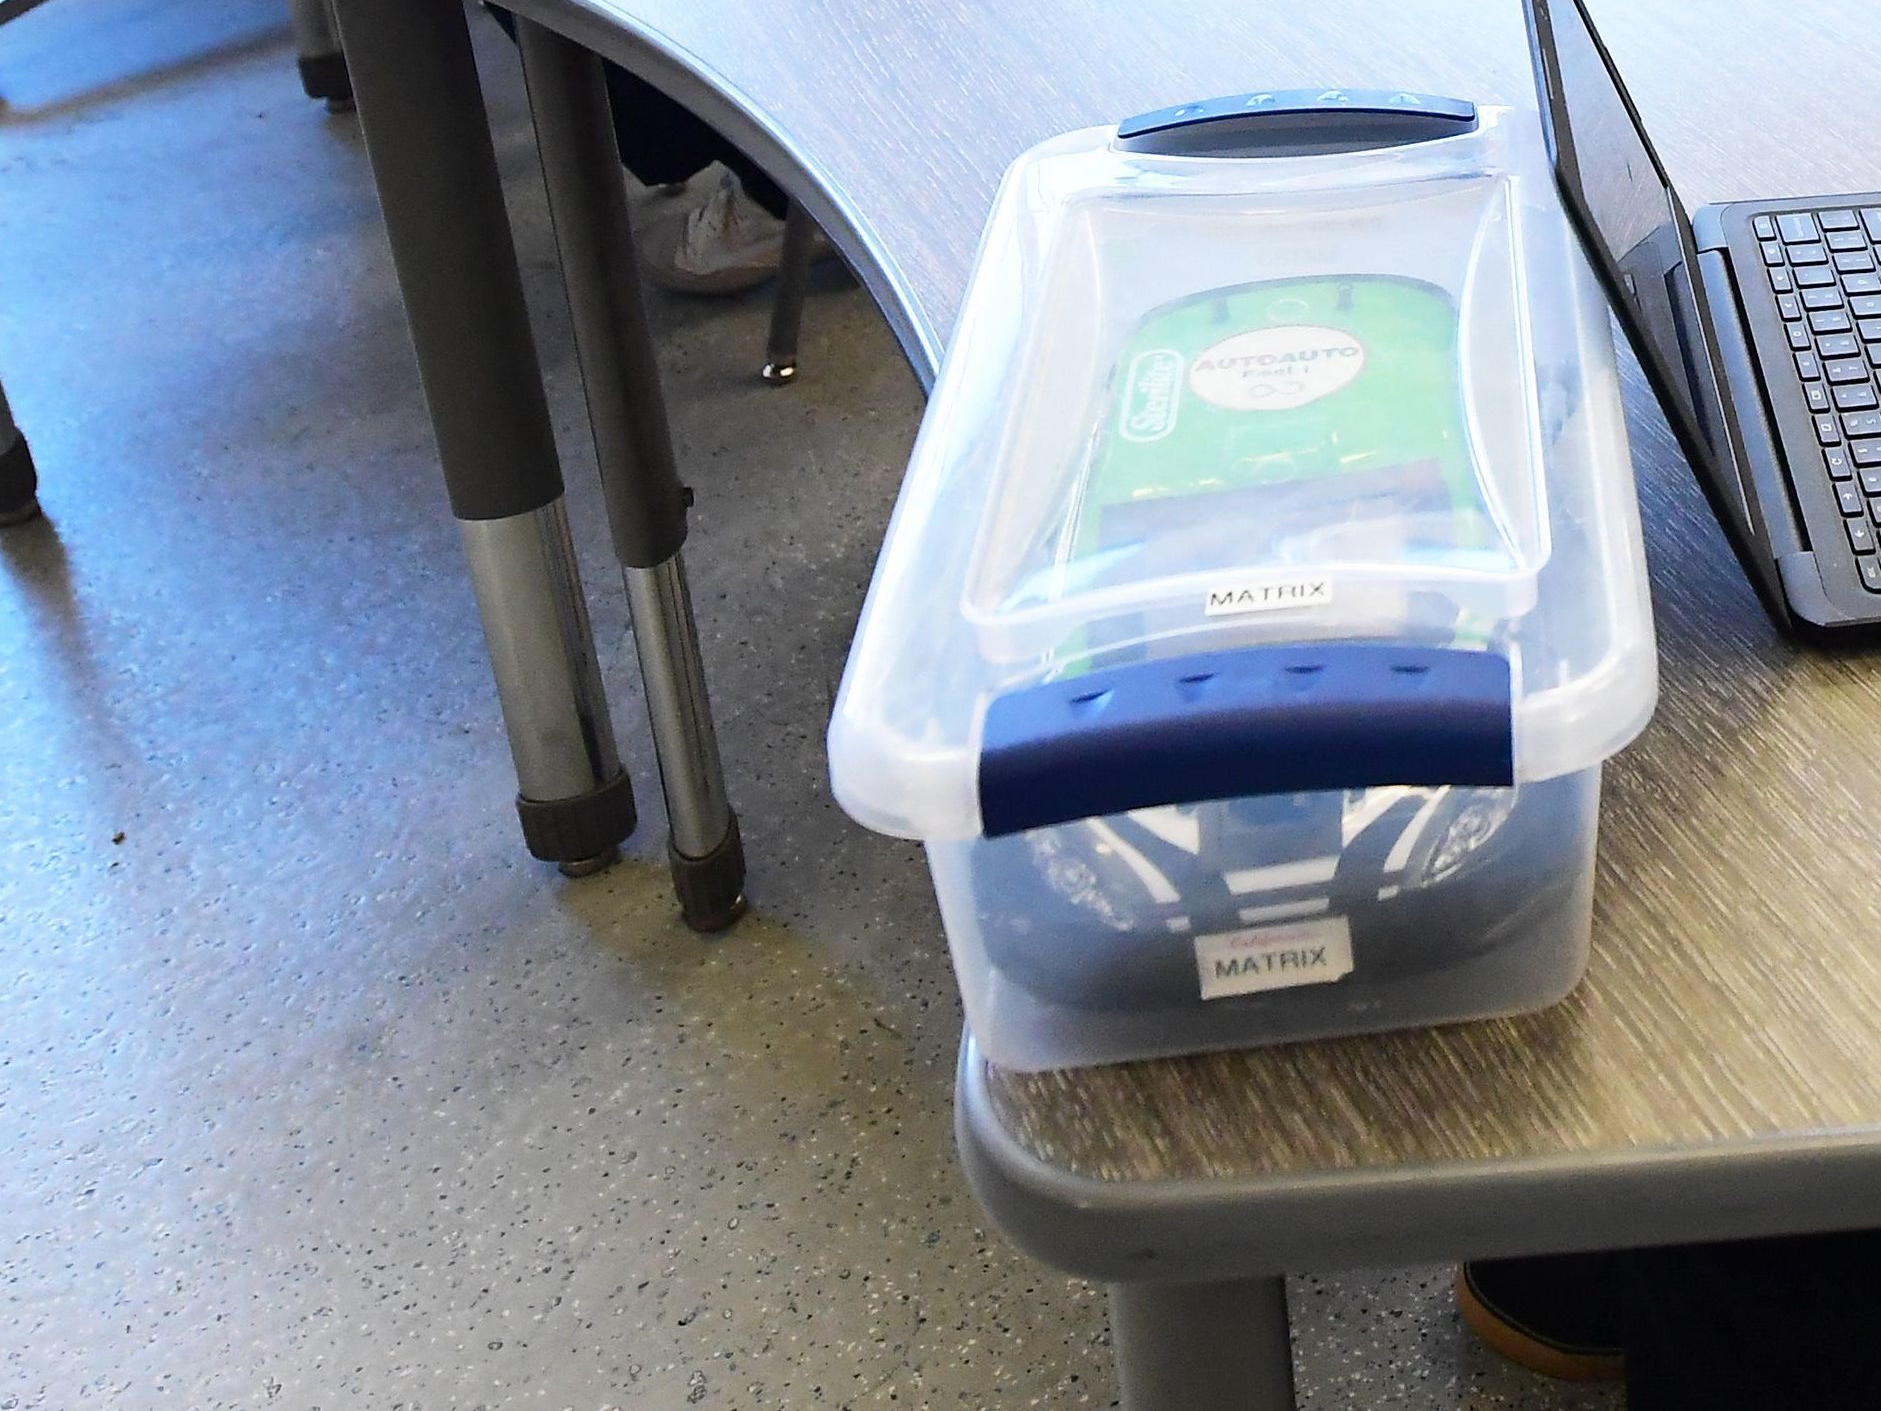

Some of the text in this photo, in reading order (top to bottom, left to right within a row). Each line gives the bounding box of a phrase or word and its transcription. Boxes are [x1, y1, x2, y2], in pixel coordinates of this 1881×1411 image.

[1195, 347, 1359, 372] AUTOAUTO
[1210, 581, 1325, 606] MATRIX
[1214, 946, 1328, 979] MATRIX
